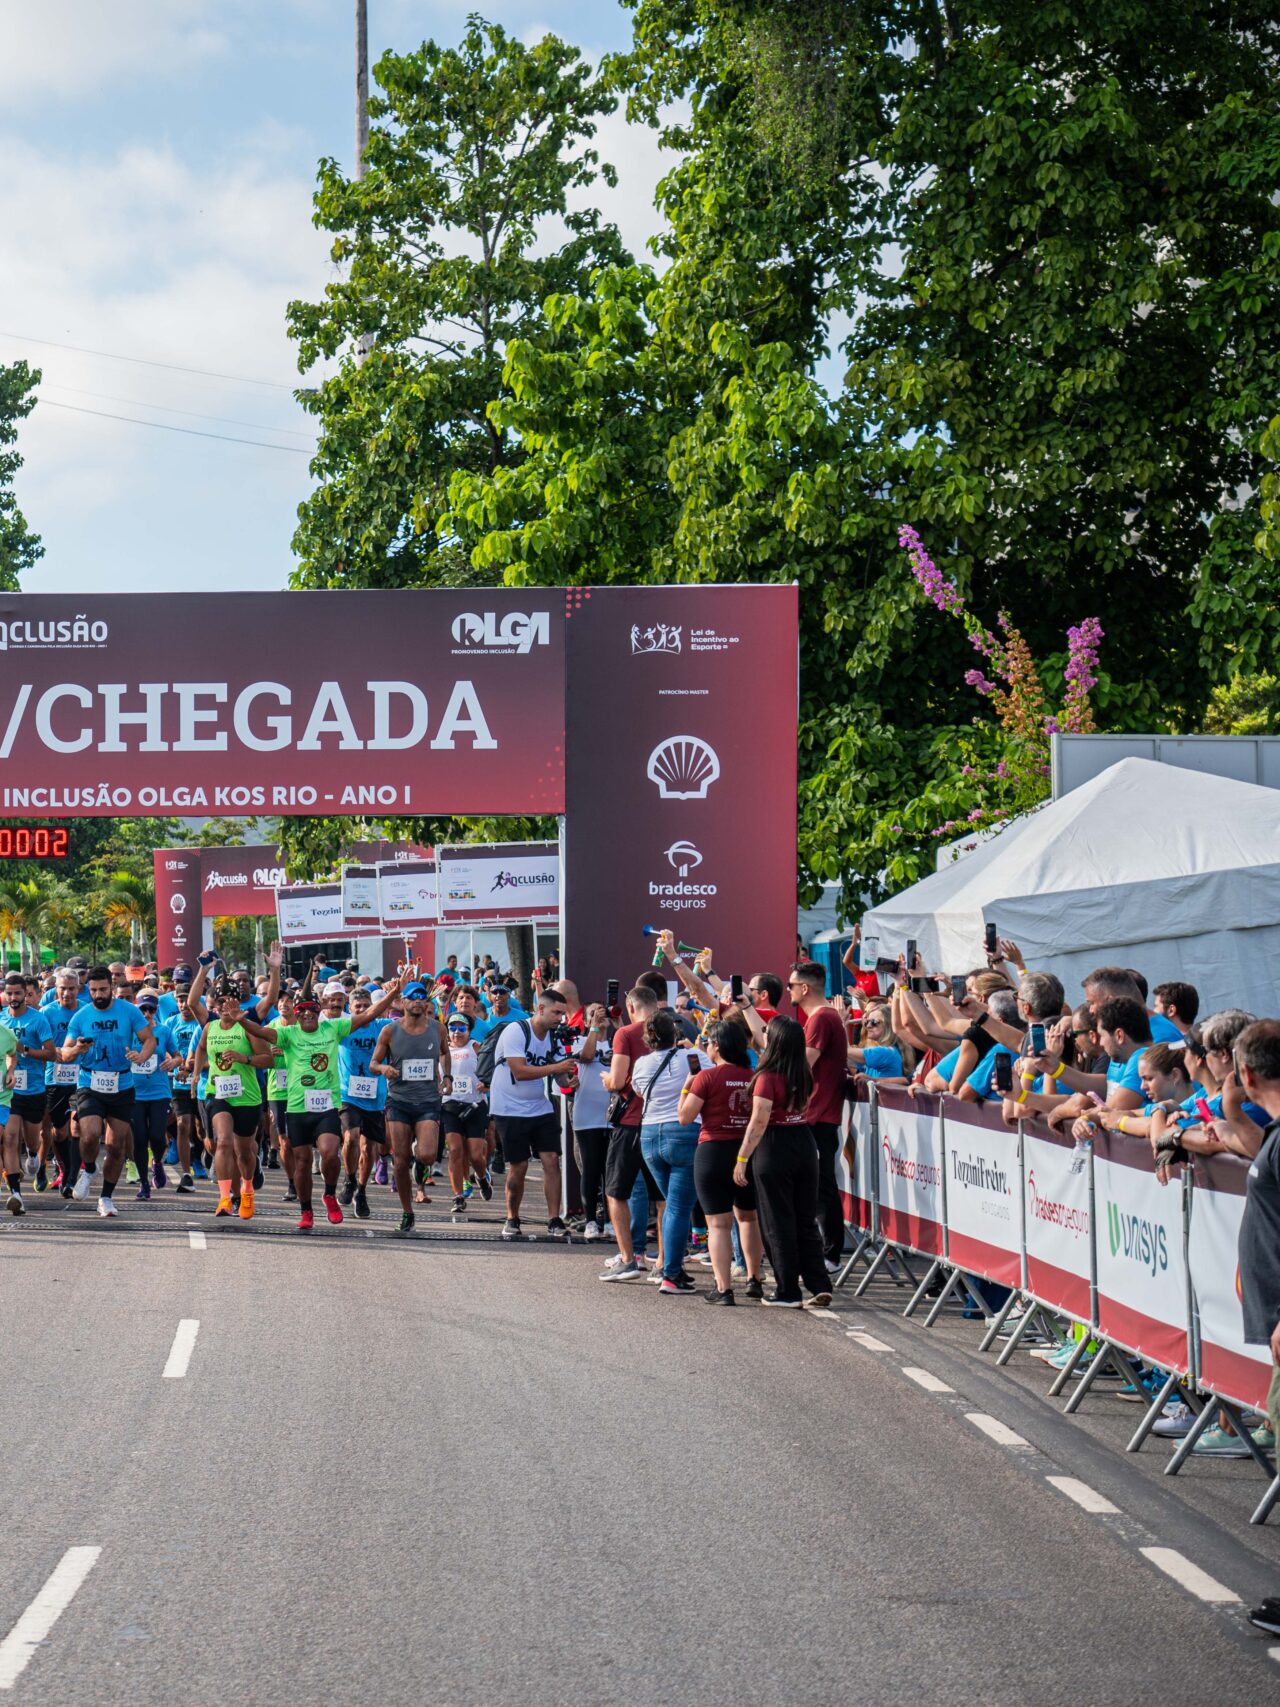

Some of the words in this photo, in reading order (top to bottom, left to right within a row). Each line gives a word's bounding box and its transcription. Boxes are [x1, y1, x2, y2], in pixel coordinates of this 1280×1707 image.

[7, 783, 131, 807] INCLUSÃO
[138, 786, 208, 807] OLGA
[215, 785, 266, 806] KOS
[272, 785, 317, 806] RIO
[340, 784, 397, 805] ANO
[405, 785, 411, 805] I
[648, 881, 718, 896] bradesco
[659, 899, 707, 912] seguros
[57, 1070, 75, 1078] 2034
[407, 1066, 428, 1074] 1487
[97, 1078, 115, 1087] 1035
[219, 1082, 239, 1092] 1032
[356, 1083, 371, 1092] 262
